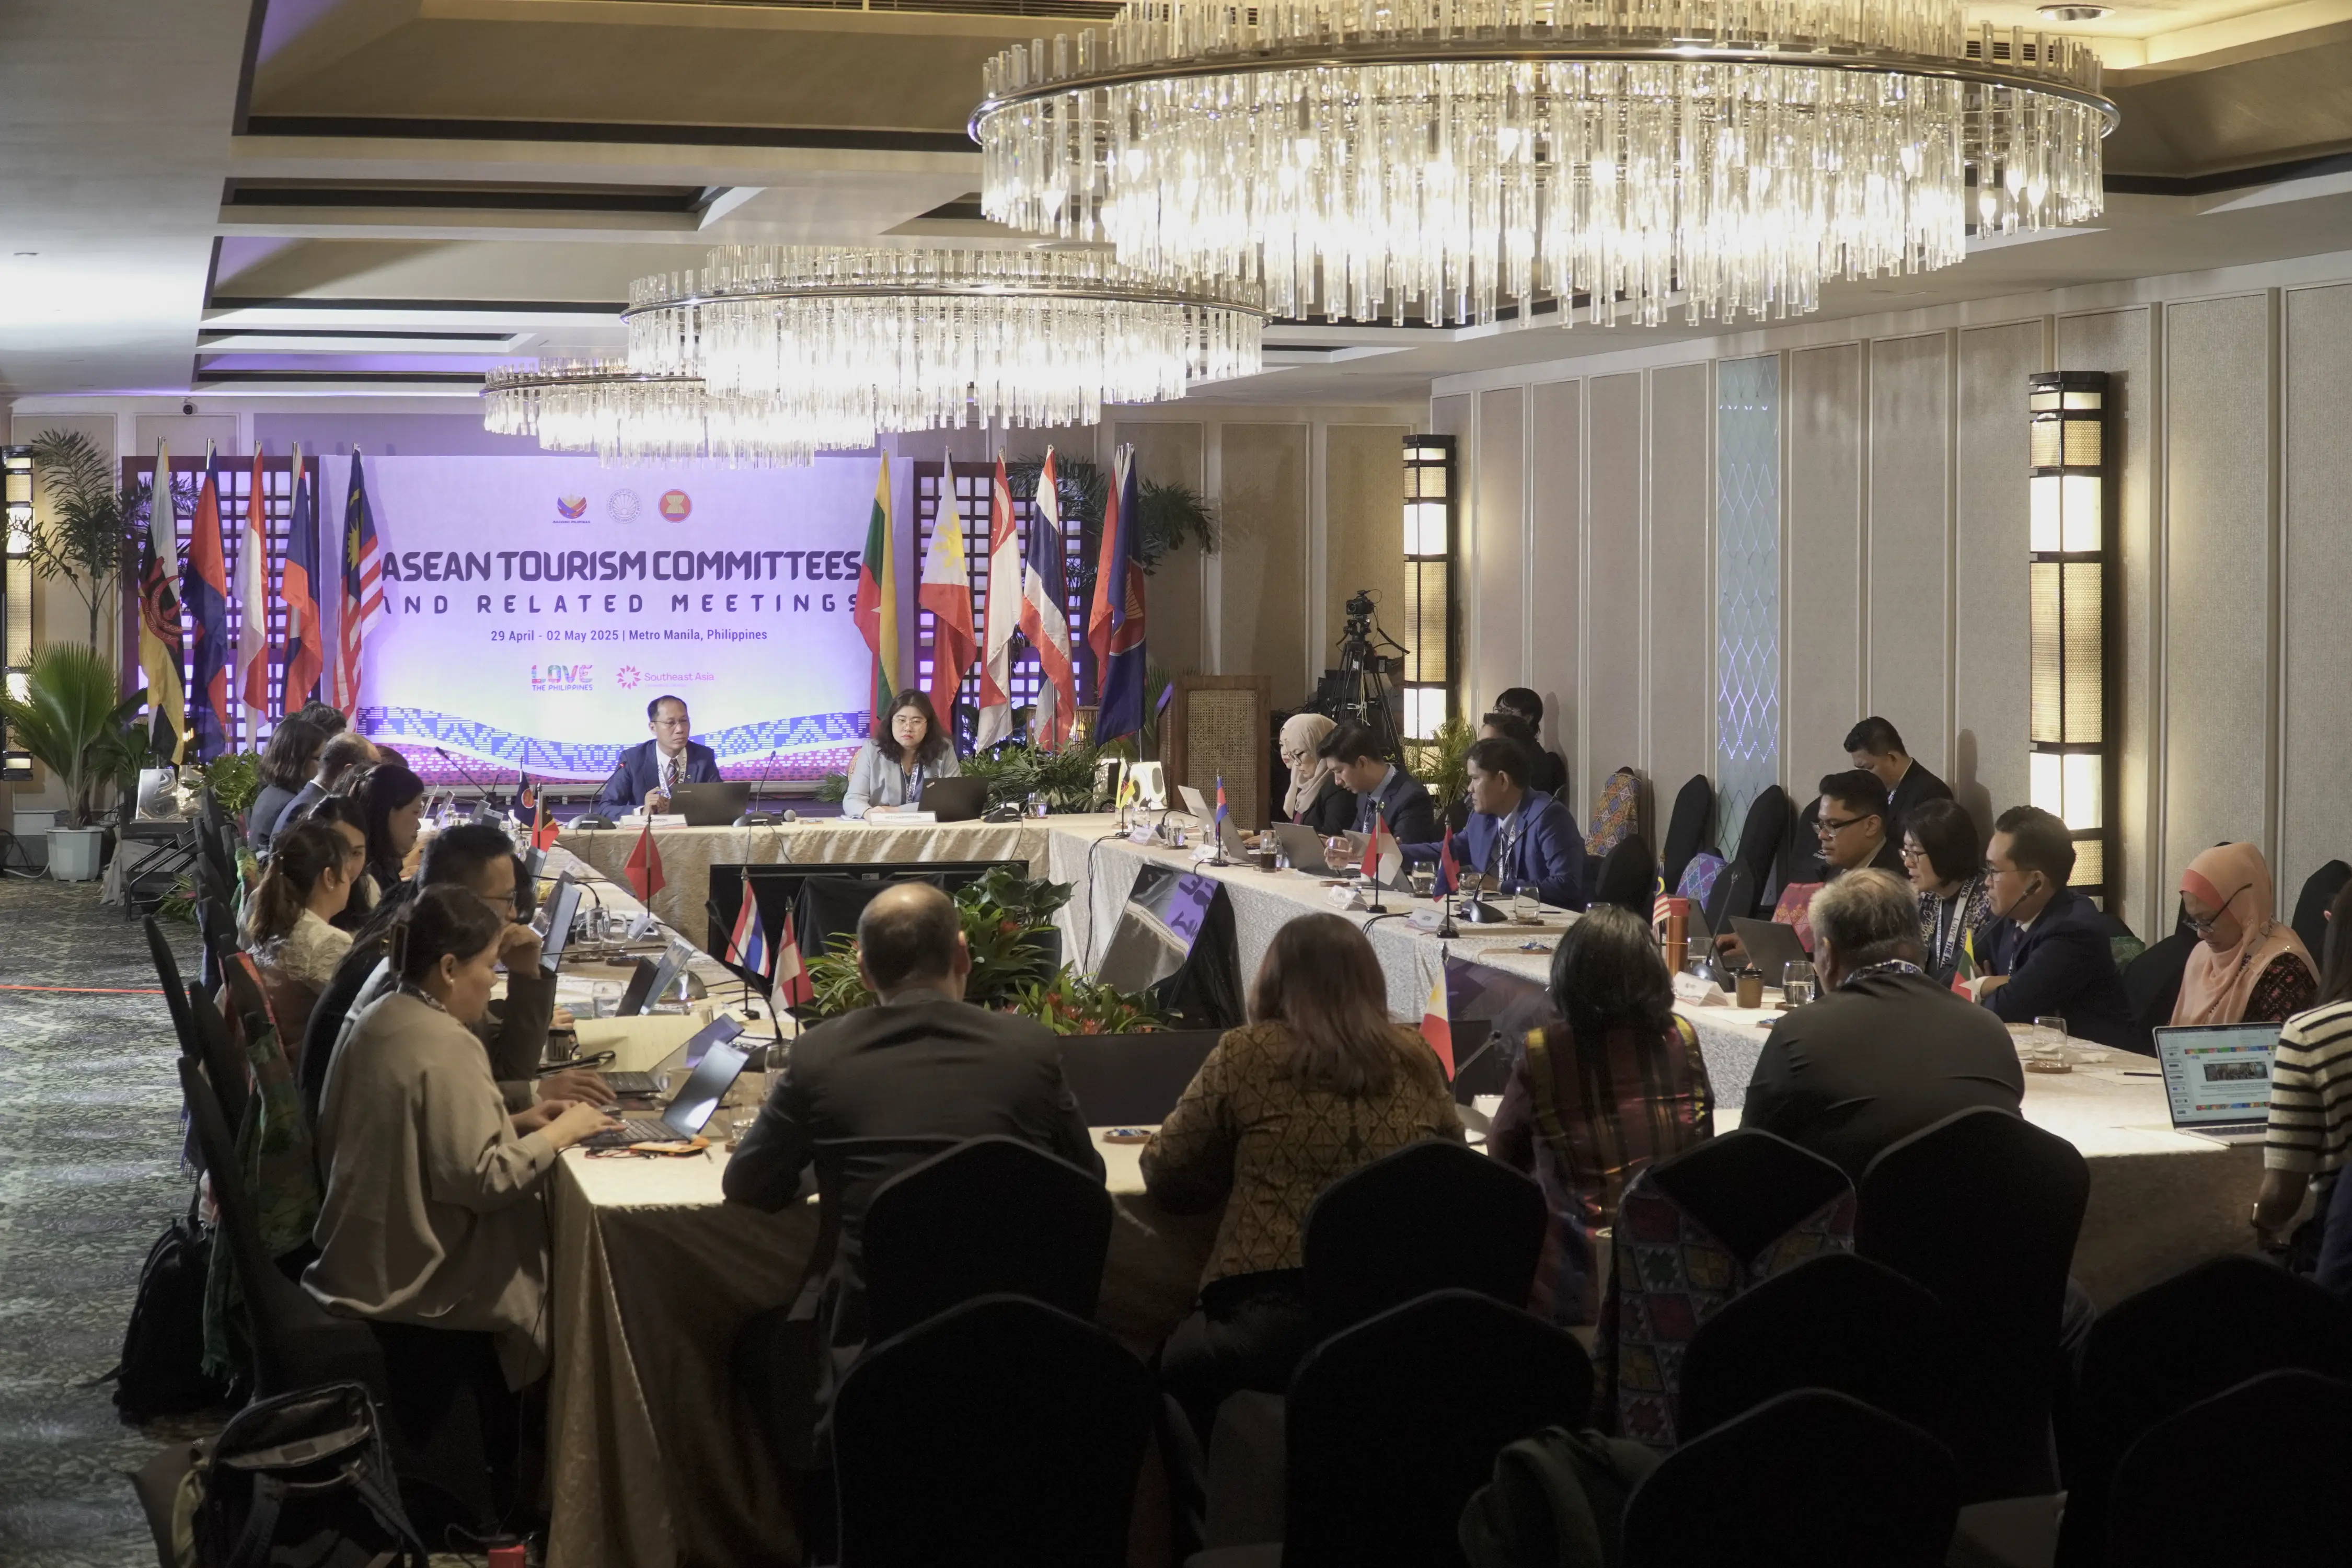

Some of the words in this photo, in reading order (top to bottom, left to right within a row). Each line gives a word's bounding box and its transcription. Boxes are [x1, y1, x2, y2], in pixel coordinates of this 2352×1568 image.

[382, 551, 491, 582] ASEAN
[496, 550, 647, 582] TOURISM
[653, 550, 861, 581] COMMITTEES
[477, 594, 642, 614] RELATED
[491, 630, 505, 641] 29
[509, 630, 534, 643] April
[547, 630, 561, 640] 02
[564, 630, 587, 643] May
[591, 630, 619, 640] 2025
[629, 630, 660, 640] Metro
[664, 629, 704, 642] Manila,
[707, 629, 767, 642] Philippines
[531, 664, 593, 684] LOVE
[644, 672, 694, 681] Southeast
[695, 672, 714, 681] Asia
[1950, 917, 1959, 941] LOVE
[1944, 940, 1954, 956] THE
